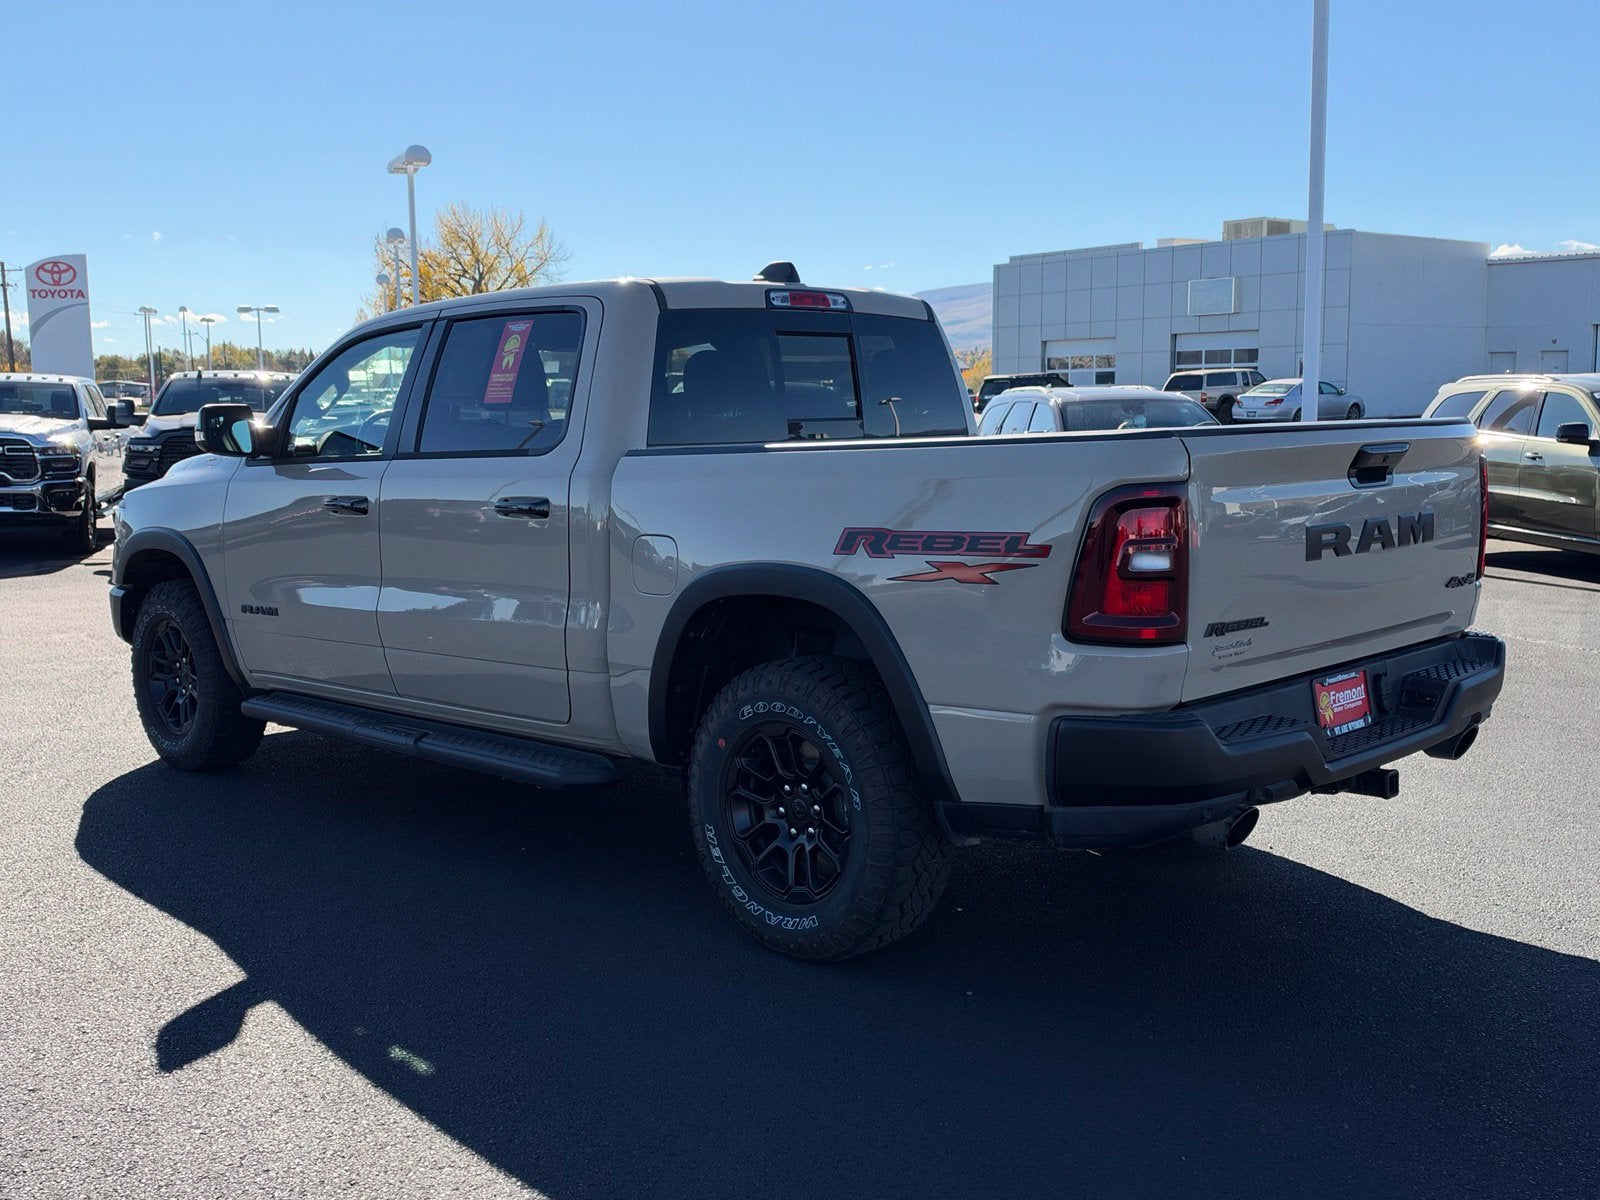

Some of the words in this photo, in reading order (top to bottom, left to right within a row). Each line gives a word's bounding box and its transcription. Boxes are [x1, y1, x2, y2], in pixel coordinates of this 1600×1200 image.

[29, 289, 86, 299] TOYOTA
[833, 527, 1053, 558] REBEL
[1305, 511, 1435, 562] RAM
[886, 561, 1039, 585] X
[240, 604, 279, 616] RAM
[1203, 616, 1270, 638] REBEL
[1330, 683, 1365, 704] Fremont
[739, 701, 861, 811] GOODYEAR
[705, 823, 818, 930] WRANGLER
